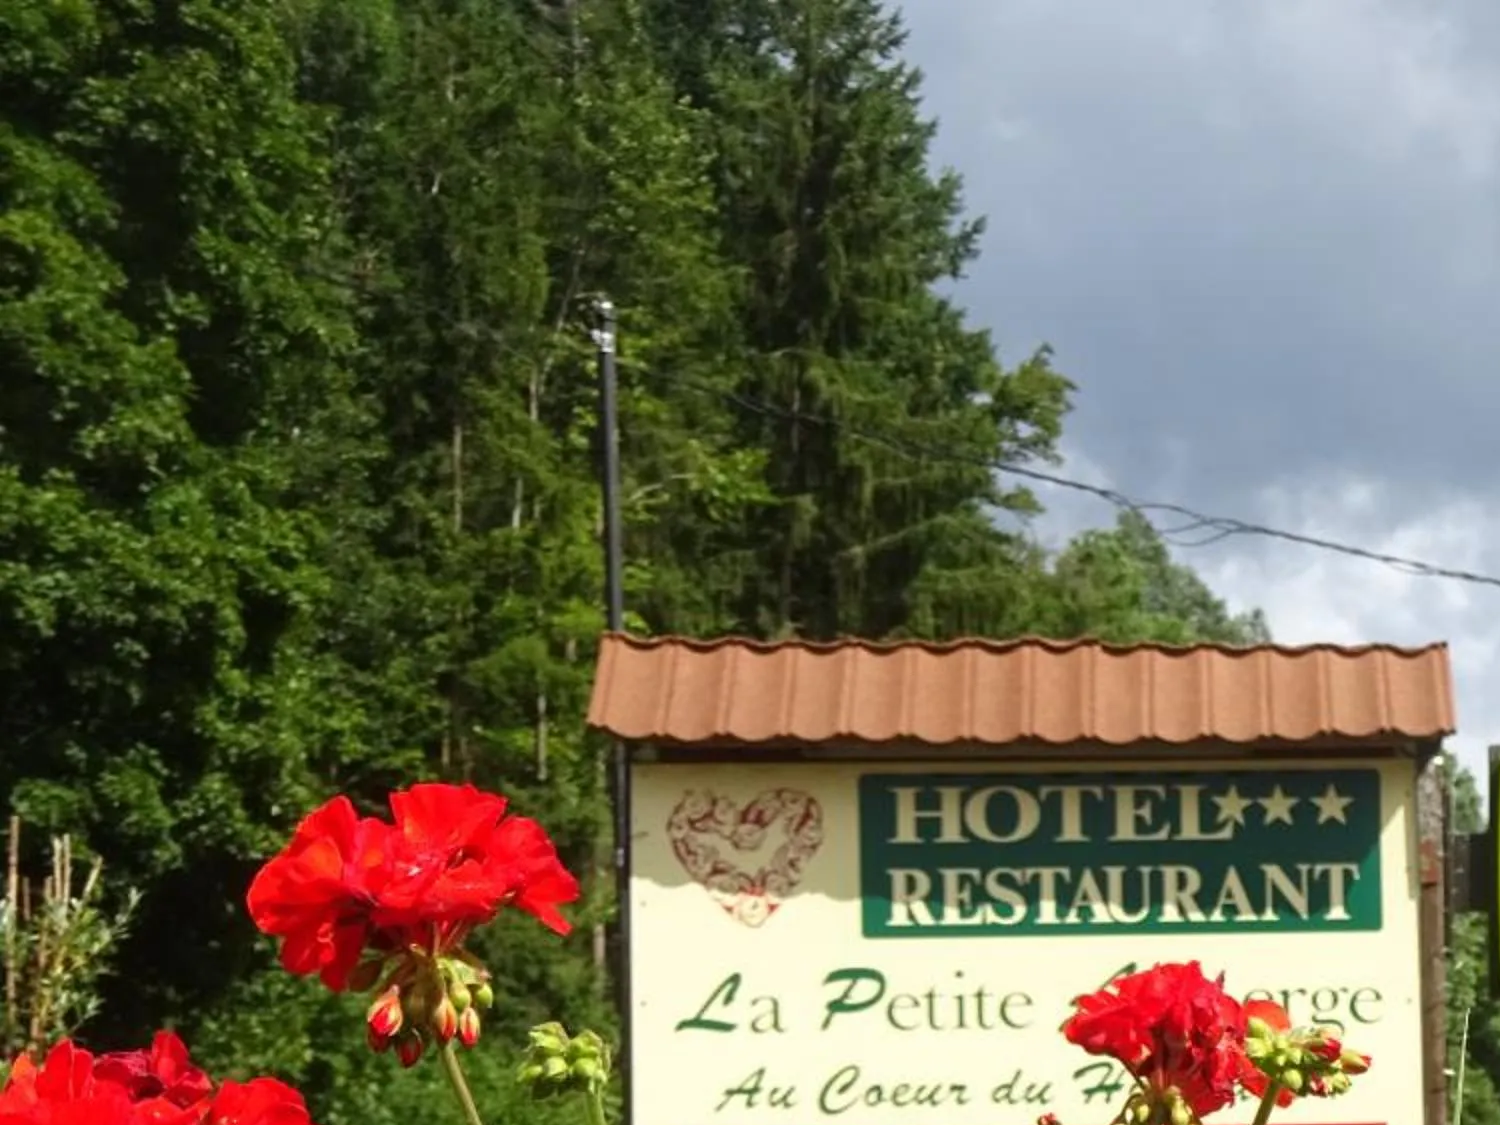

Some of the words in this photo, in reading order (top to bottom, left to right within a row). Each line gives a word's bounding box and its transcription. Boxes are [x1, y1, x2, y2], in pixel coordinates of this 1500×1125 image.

[886, 784, 1236, 844] HOTEL
[886, 863, 1361, 926] RESTAURANT
[675, 972, 788, 1034] La
[821, 967, 1034, 1032] Petite
[714, 1067, 798, 1113] Au
[817, 1065, 972, 1115] Coeur
[991, 1069, 1053, 1106] du
